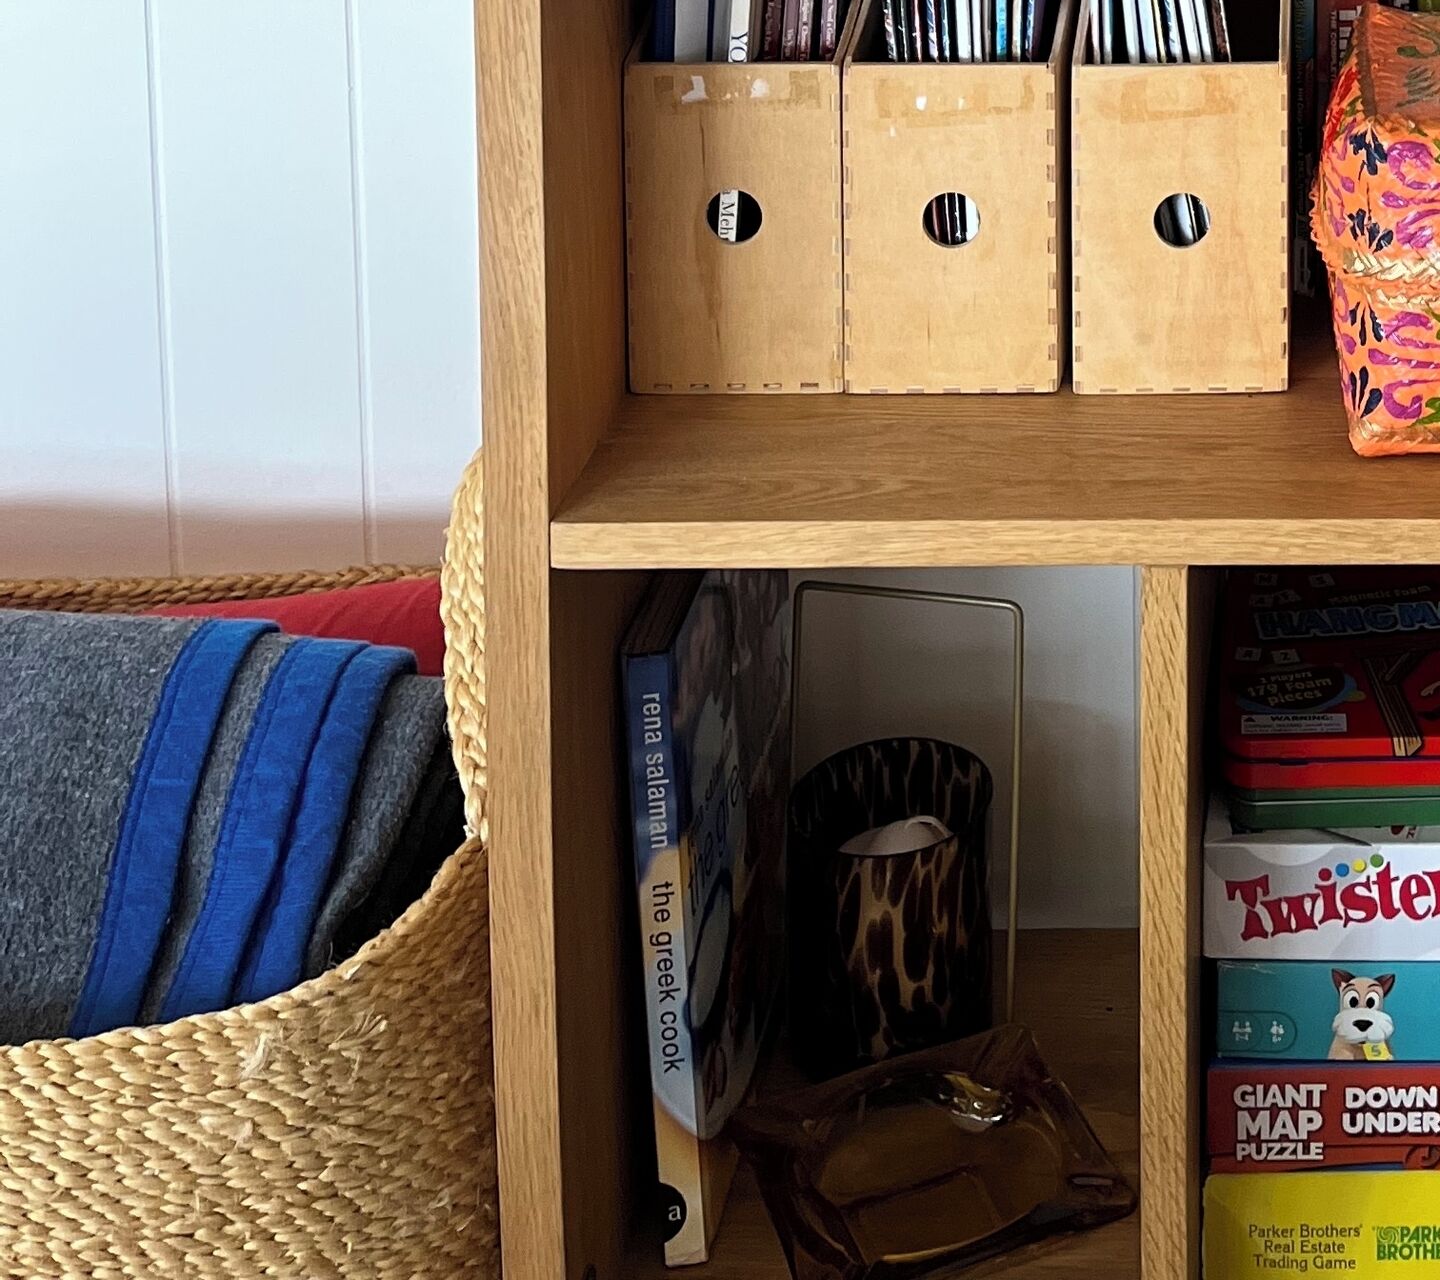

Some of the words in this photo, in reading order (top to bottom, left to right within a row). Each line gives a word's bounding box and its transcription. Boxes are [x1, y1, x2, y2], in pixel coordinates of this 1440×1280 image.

[1267, 689, 1323, 707] pieces
[641, 693, 663, 745] rena
[645, 752, 669, 850] salaman
[652, 881, 671, 923] the
[650, 930, 681, 1003] greek
[659, 1011, 681, 1074] cook
[1233, 1084, 1327, 1108] GIANT
[1344, 1086, 1439, 1109] DOWN
[1236, 1110, 1323, 1141] MAP
[1236, 1141, 1324, 1161] PUZZLE
[1249, 1224, 1293, 1238] Parker
[1263, 1241, 1293, 1255] Real
[1300, 1240, 1346, 1254] Estate
[1252, 1255, 1308, 1272] Trading
[1312, 1255, 1358, 1271] Game
